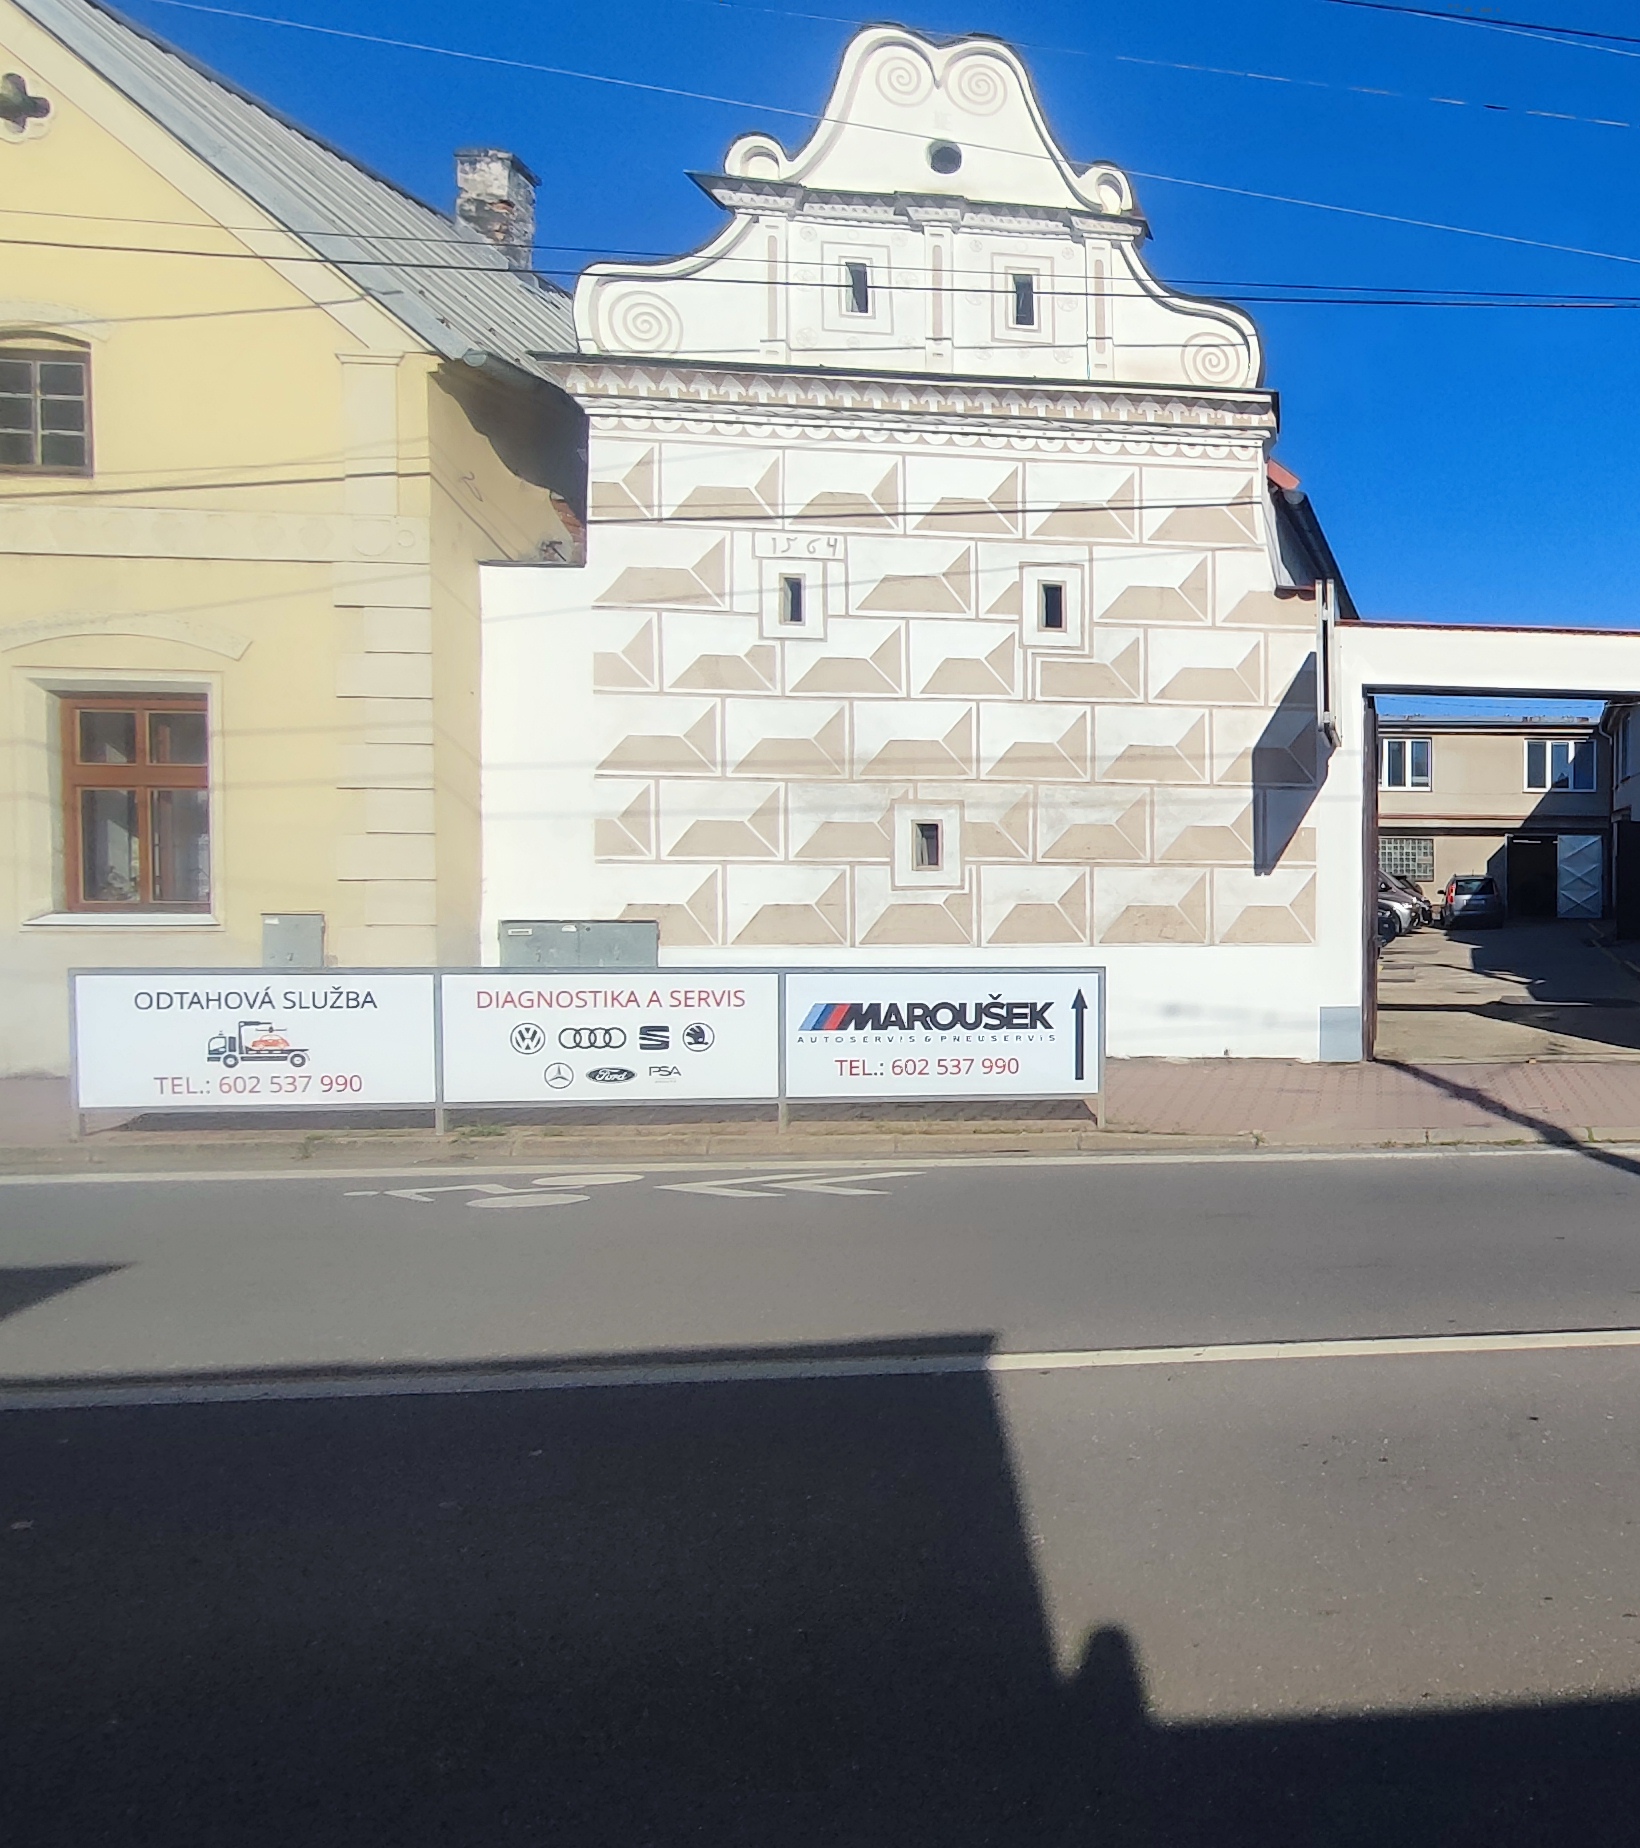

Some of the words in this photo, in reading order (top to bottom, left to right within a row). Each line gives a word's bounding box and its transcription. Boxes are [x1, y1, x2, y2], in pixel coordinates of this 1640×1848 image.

[771, 537, 838, 557] 1564
[133, 986, 277, 1011] ODTAHOVÁ
[282, 986, 378, 1010] SLUŽBA
[476, 989, 641, 1009] DIAGNOSTIKA
[646, 990, 663, 1008] A
[669, 989, 746, 1008] SERVIS
[840, 993, 1055, 1031] MAROUŠEK
[595, 1069, 629, 1081] Ford
[648, 1065, 682, 1077] PSA
[834, 1059, 885, 1077] TEL.:
[891, 1058, 930, 1076] 602
[936, 1058, 975, 1076] 537
[981, 1057, 1020, 1075] 990
[154, 1076, 211, 1095] TEL.:
[219, 1076, 261, 1094] 602
[270, 1075, 312, 1093] 537
[320, 1074, 363, 1092] 990
